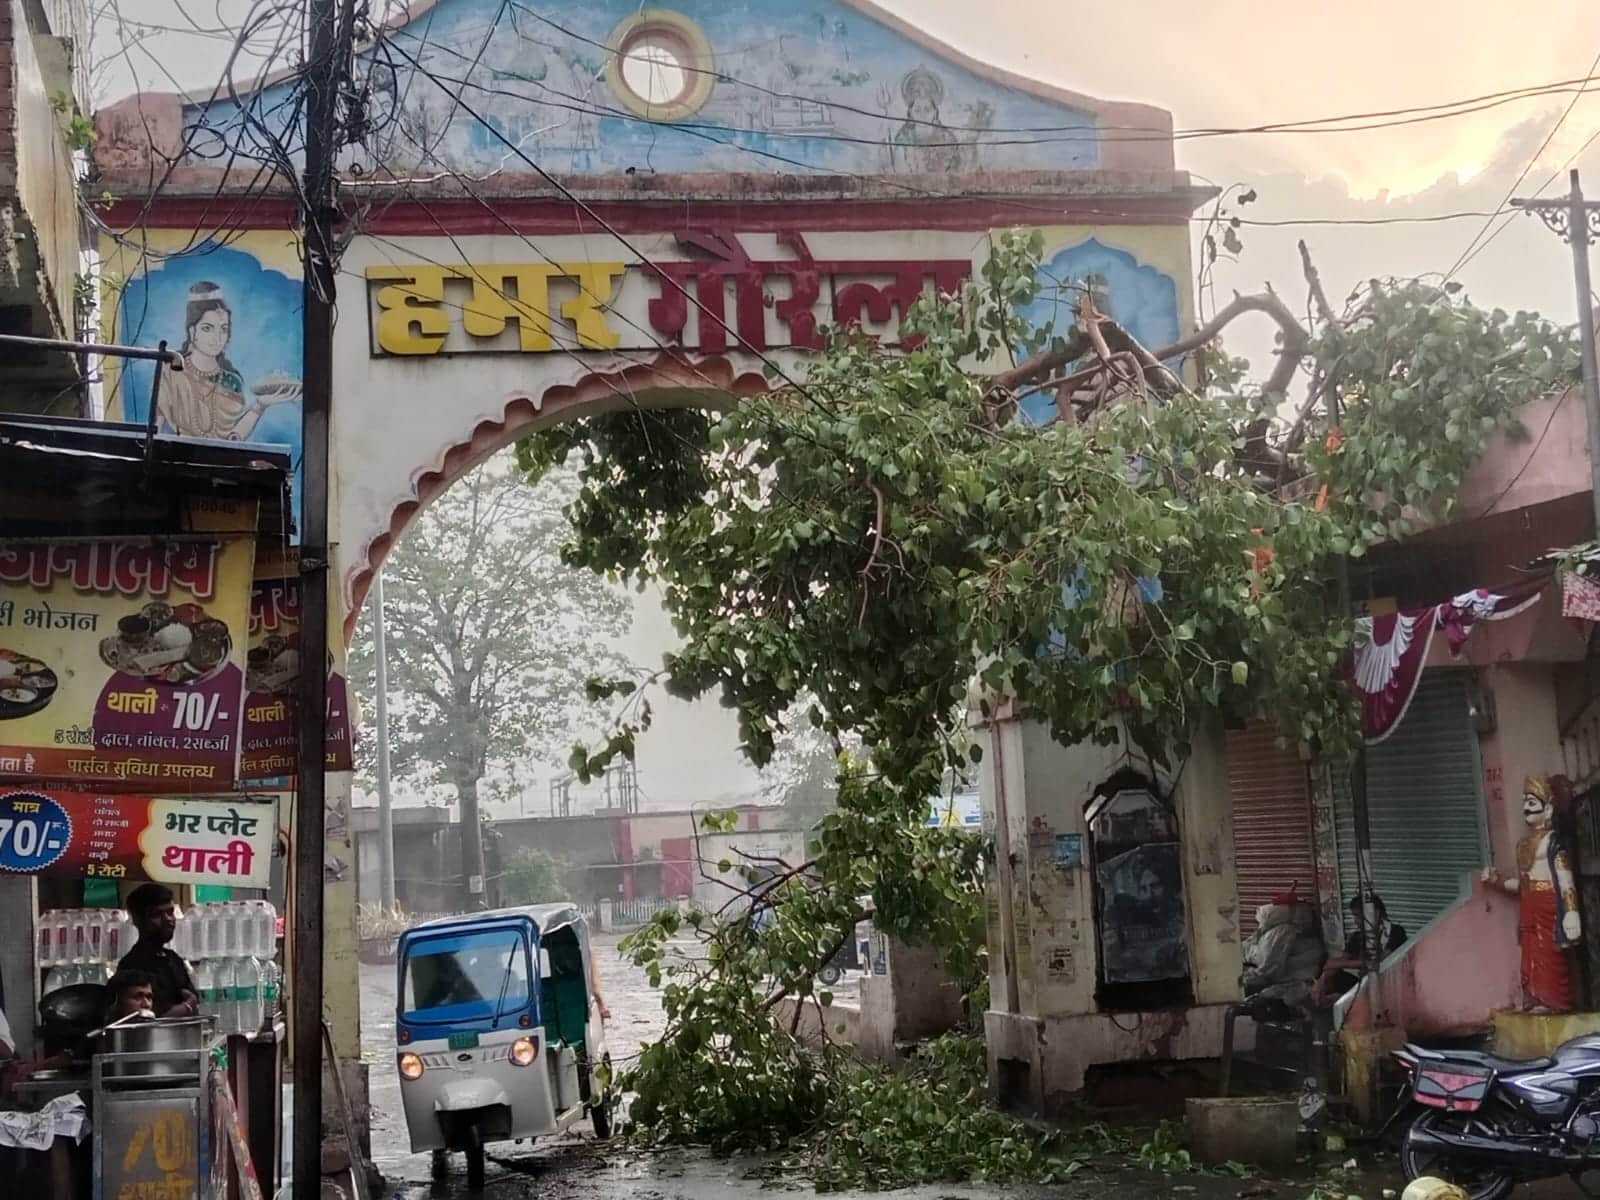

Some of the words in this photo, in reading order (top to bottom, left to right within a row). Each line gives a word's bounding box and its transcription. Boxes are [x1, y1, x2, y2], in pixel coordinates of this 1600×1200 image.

[365, 261, 626, 356] हमर
[23, 601, 100, 632] भोजन
[107, 688, 159, 714] थाली
[173, 691, 229, 731] 70/-
[247, 701, 286, 723] थाली
[67, 756, 109, 774] पार्सल
[113, 758, 158, 780] सुविधा
[162, 763, 216, 779] उपलब्ध
[13, 801, 41, 813] मात्र
[165, 812, 202, 834] भर
[207, 808, 259, 836] प्लेट
[0, 819, 61, 857] 70/-
[87, 864, 96, 875] 5
[98, 864, 127, 877] रोटी
[161, 840, 255, 876] थाली
